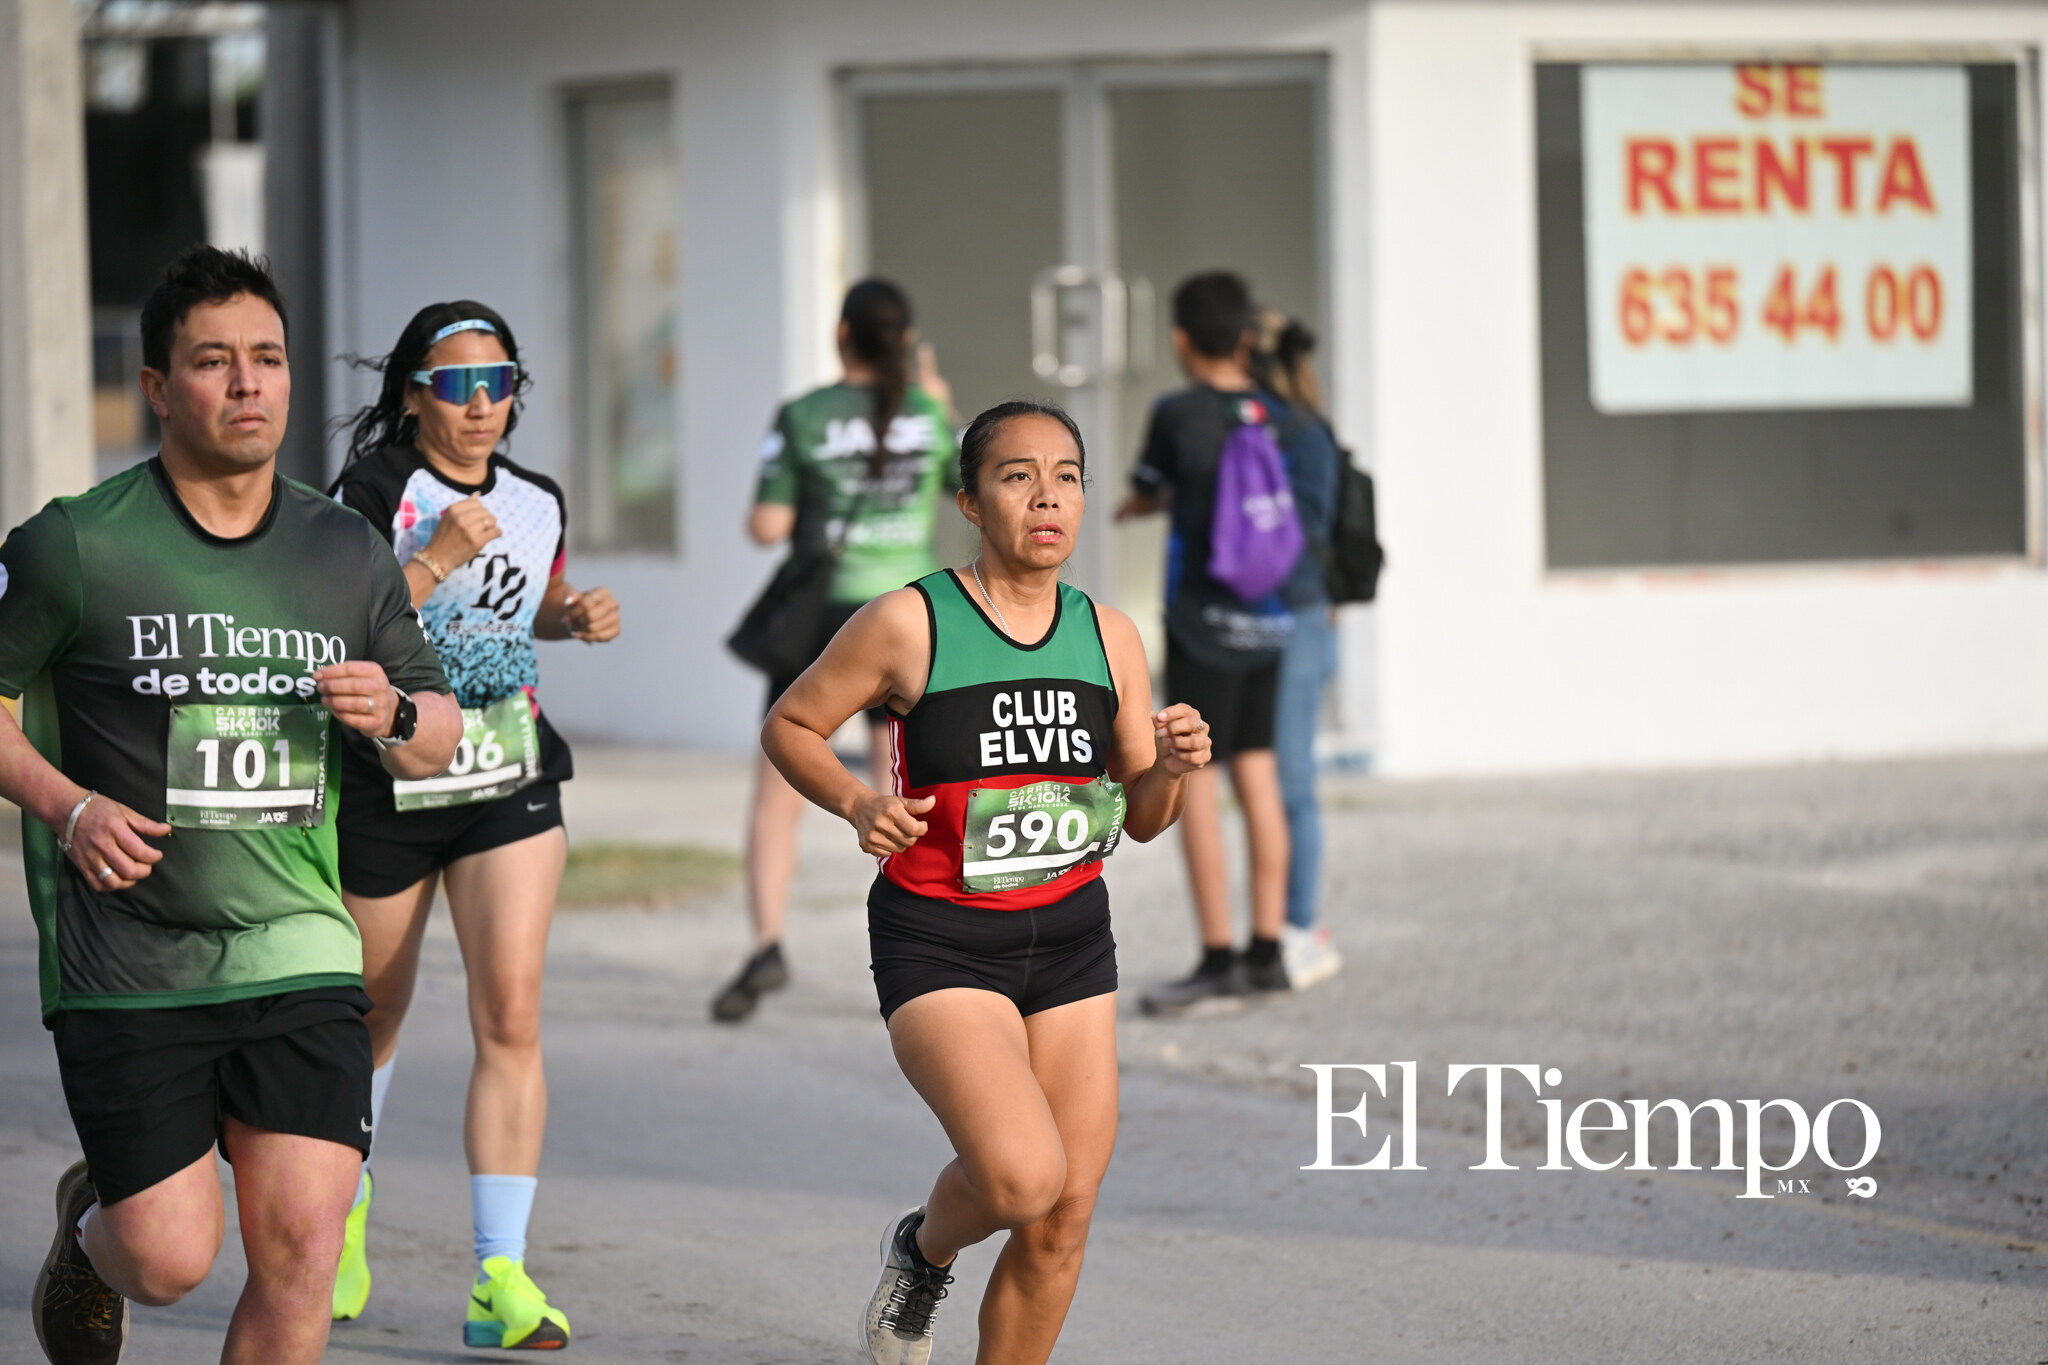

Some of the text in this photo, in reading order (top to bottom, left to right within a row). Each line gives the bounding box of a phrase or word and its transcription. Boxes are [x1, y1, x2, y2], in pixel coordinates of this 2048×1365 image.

[1733, 64, 1825, 119] SE
[1625, 135, 1937, 217] RENTA
[1618, 262, 1943, 348] 635 44 00
[126, 613, 346, 673] El Tiempo
[132, 666, 317, 697] de todos
[216, 706, 280, 716] CARRERA
[992, 690, 1077, 728] CLUB
[196, 739, 290, 789] 101
[316, 730, 326, 810] MEDALLA
[448, 730, 504, 775] 06
[979, 728, 1093, 767] ELVIS
[1010, 784, 1071, 798] CARRERA
[986, 810, 1088, 858] 590
[1103, 791, 1123, 852] MEDALLA
